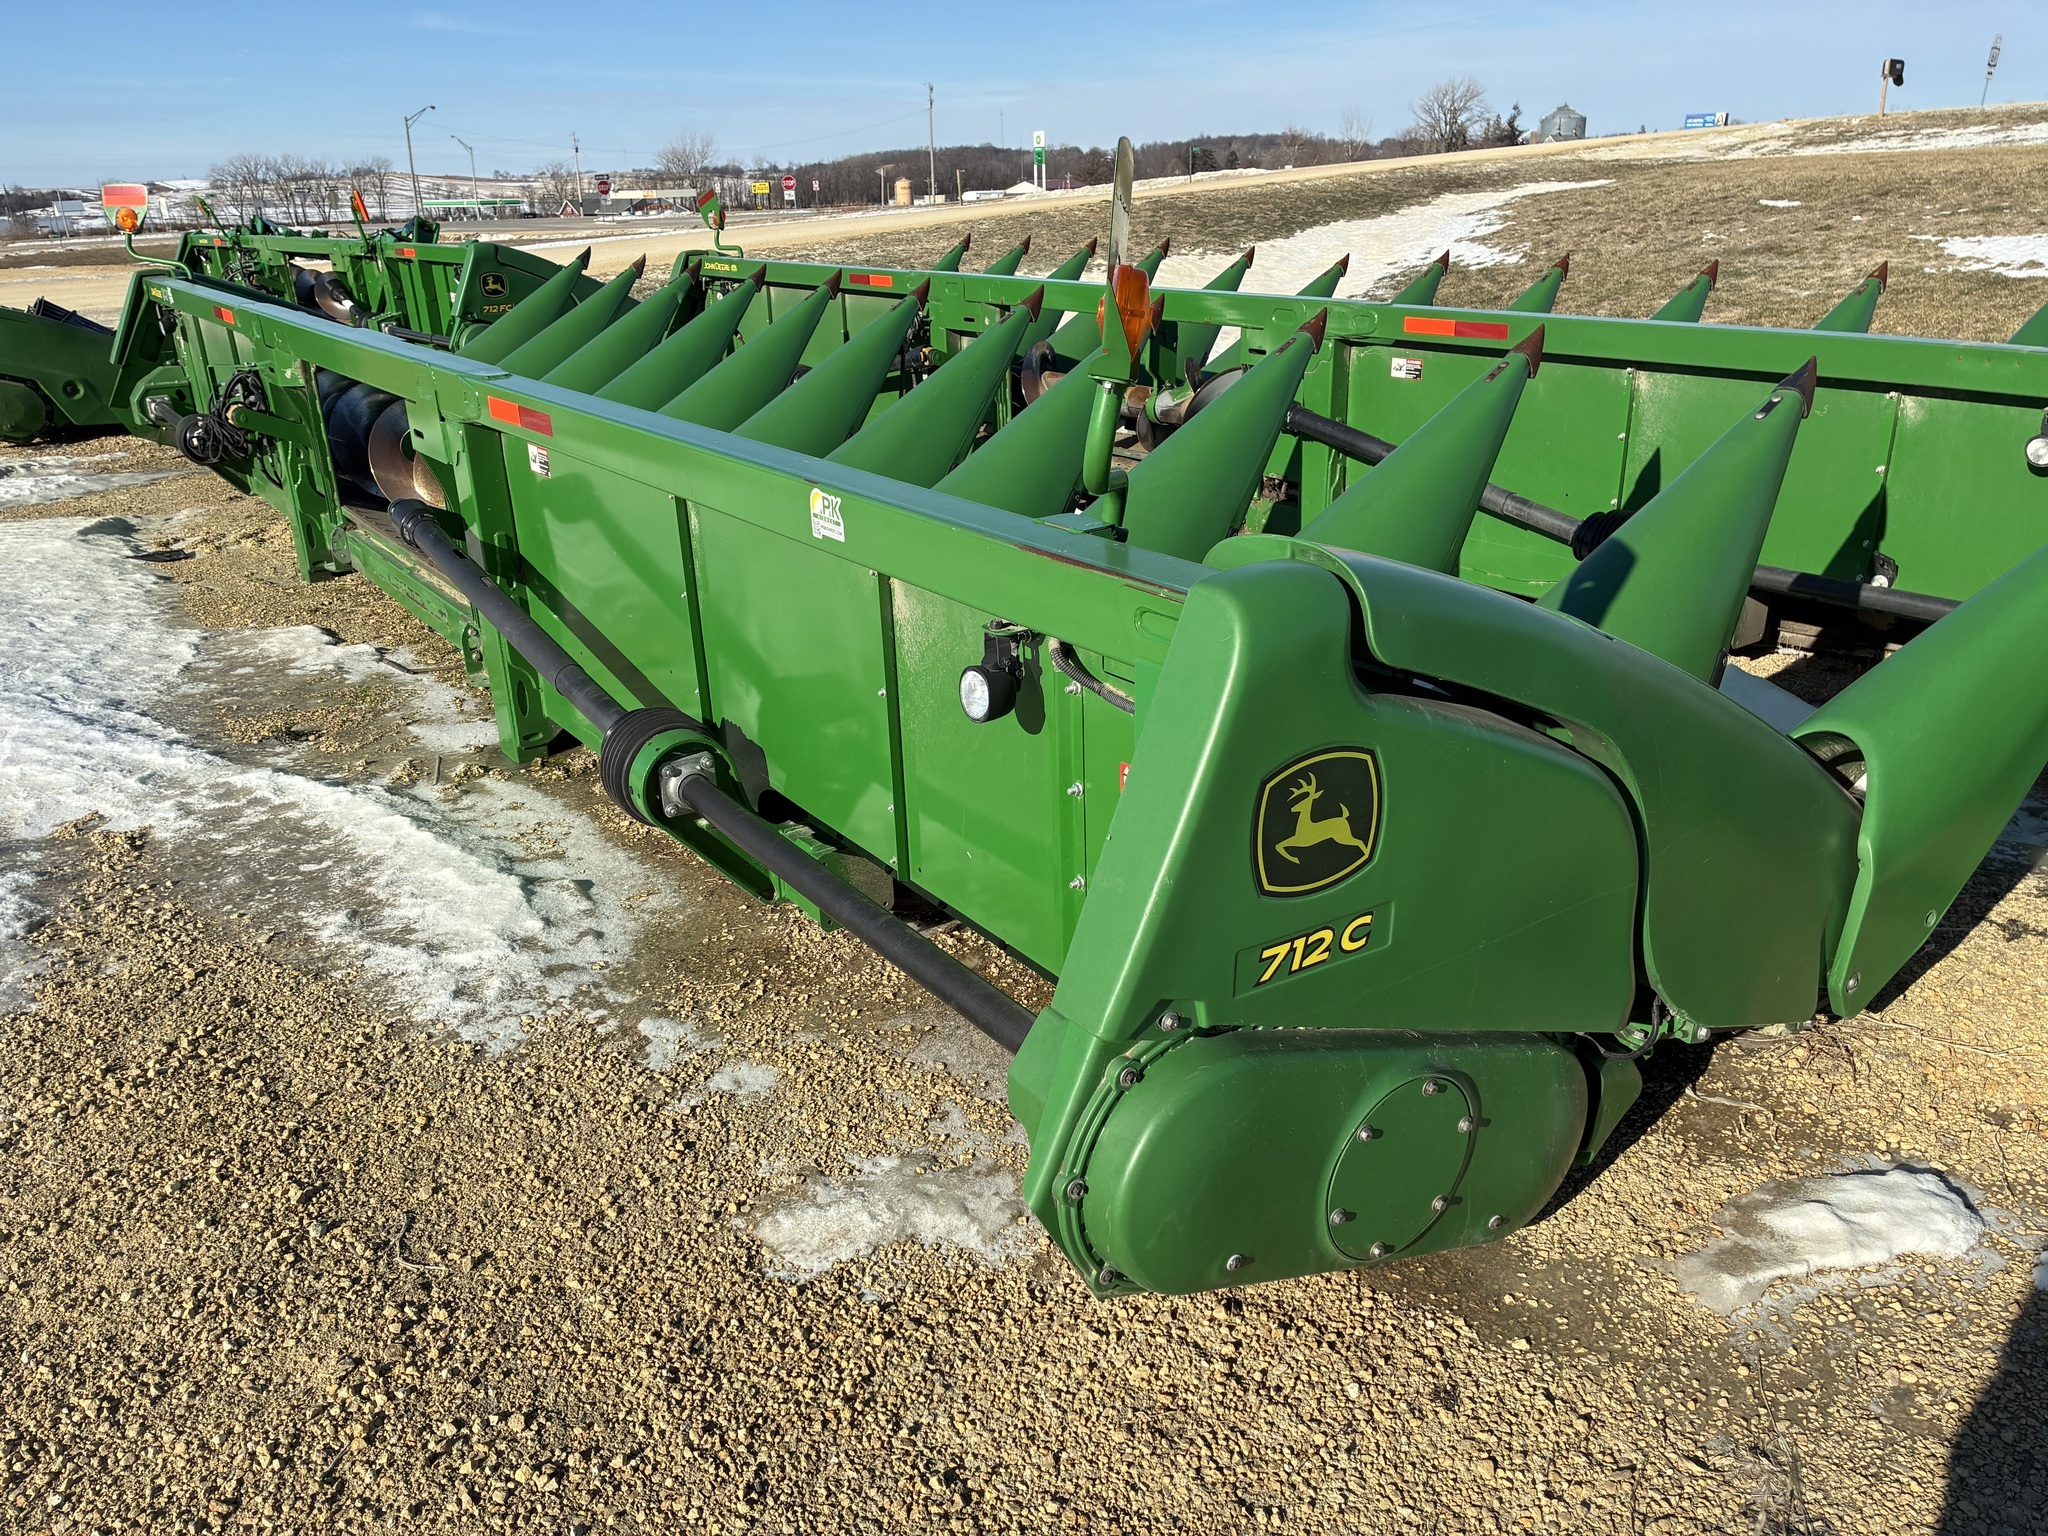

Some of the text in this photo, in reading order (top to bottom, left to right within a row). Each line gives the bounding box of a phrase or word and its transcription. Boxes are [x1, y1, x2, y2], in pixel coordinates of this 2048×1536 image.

[483, 305, 499, 313] 712
[1254, 911, 1374, 987] 712 C
